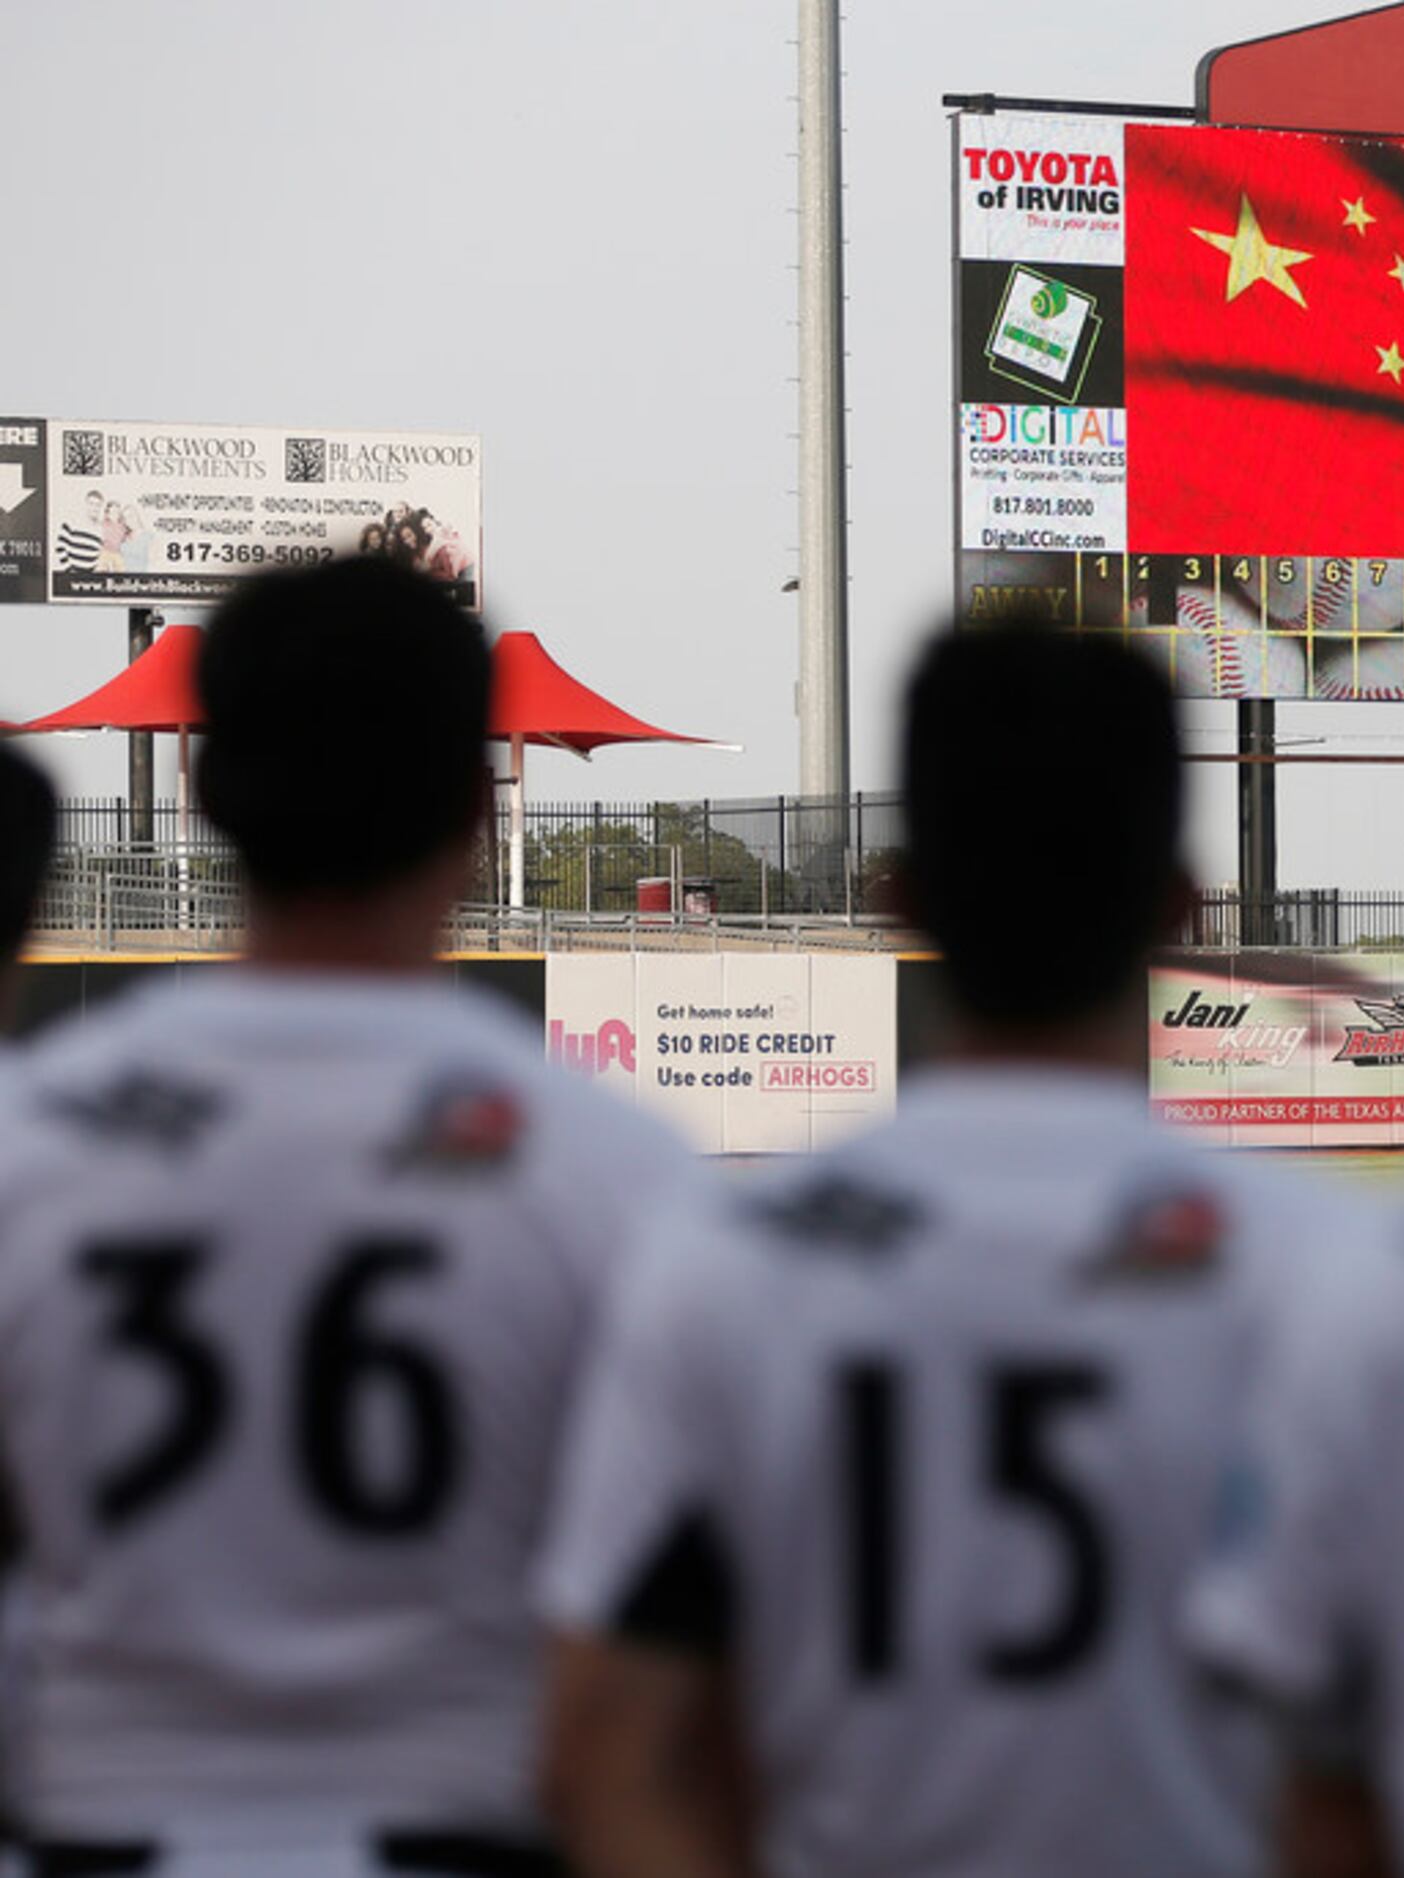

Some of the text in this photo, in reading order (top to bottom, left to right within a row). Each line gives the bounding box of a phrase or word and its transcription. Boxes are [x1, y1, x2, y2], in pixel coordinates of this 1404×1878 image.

[964, 148, 1118, 187] TOYOTA
[978, 186, 1119, 214] of IRVING
[981, 405, 1125, 446] DIGITAL
[108, 434, 256, 459] BLACKWOOD
[329, 443, 475, 467] BLACKWOOD
[970, 448, 1126, 467] CORPORATE SERVICES
[108, 457, 267, 480] INVESTMENTS
[329, 463, 409, 484] HOMES
[970, 468, 1007, 482] Printing
[1013, 468, 1059, 483] Corporate
[993, 496, 1094, 517] 817.801.8000
[982, 528, 1105, 551] DigitalCCinc.com
[167, 542, 333, 565] 817-369-5092
[1095, 555, 1108, 579] 1
[1137, 555, 1149, 579] 2
[1184, 558, 1202, 580] 3
[1233, 559, 1251, 582] 4
[1278, 560, 1294, 582] 5
[1324, 560, 1341, 583] 6
[1369, 561, 1386, 584] 7
[657, 1003, 774, 1020] Get home safe!
[1162, 990, 1250, 1028] Jani
[550, 1019, 636, 1077] lyft
[657, 1033, 836, 1056] $10 RIDE CREDIT
[1217, 1019, 1308, 1068] king
[657, 1066, 870, 1087] Use code AIRHOGS
[1164, 1103, 1218, 1121] PROUD
[1220, 1102, 1286, 1120] PARTNER
[1288, 1102, 1308, 1119] OF
[1313, 1102, 1341, 1119] THE
[1344, 1101, 1389, 1119] TEXAS
[72, 1232, 464, 1543] 36
[838, 1352, 1120, 1688] 15
